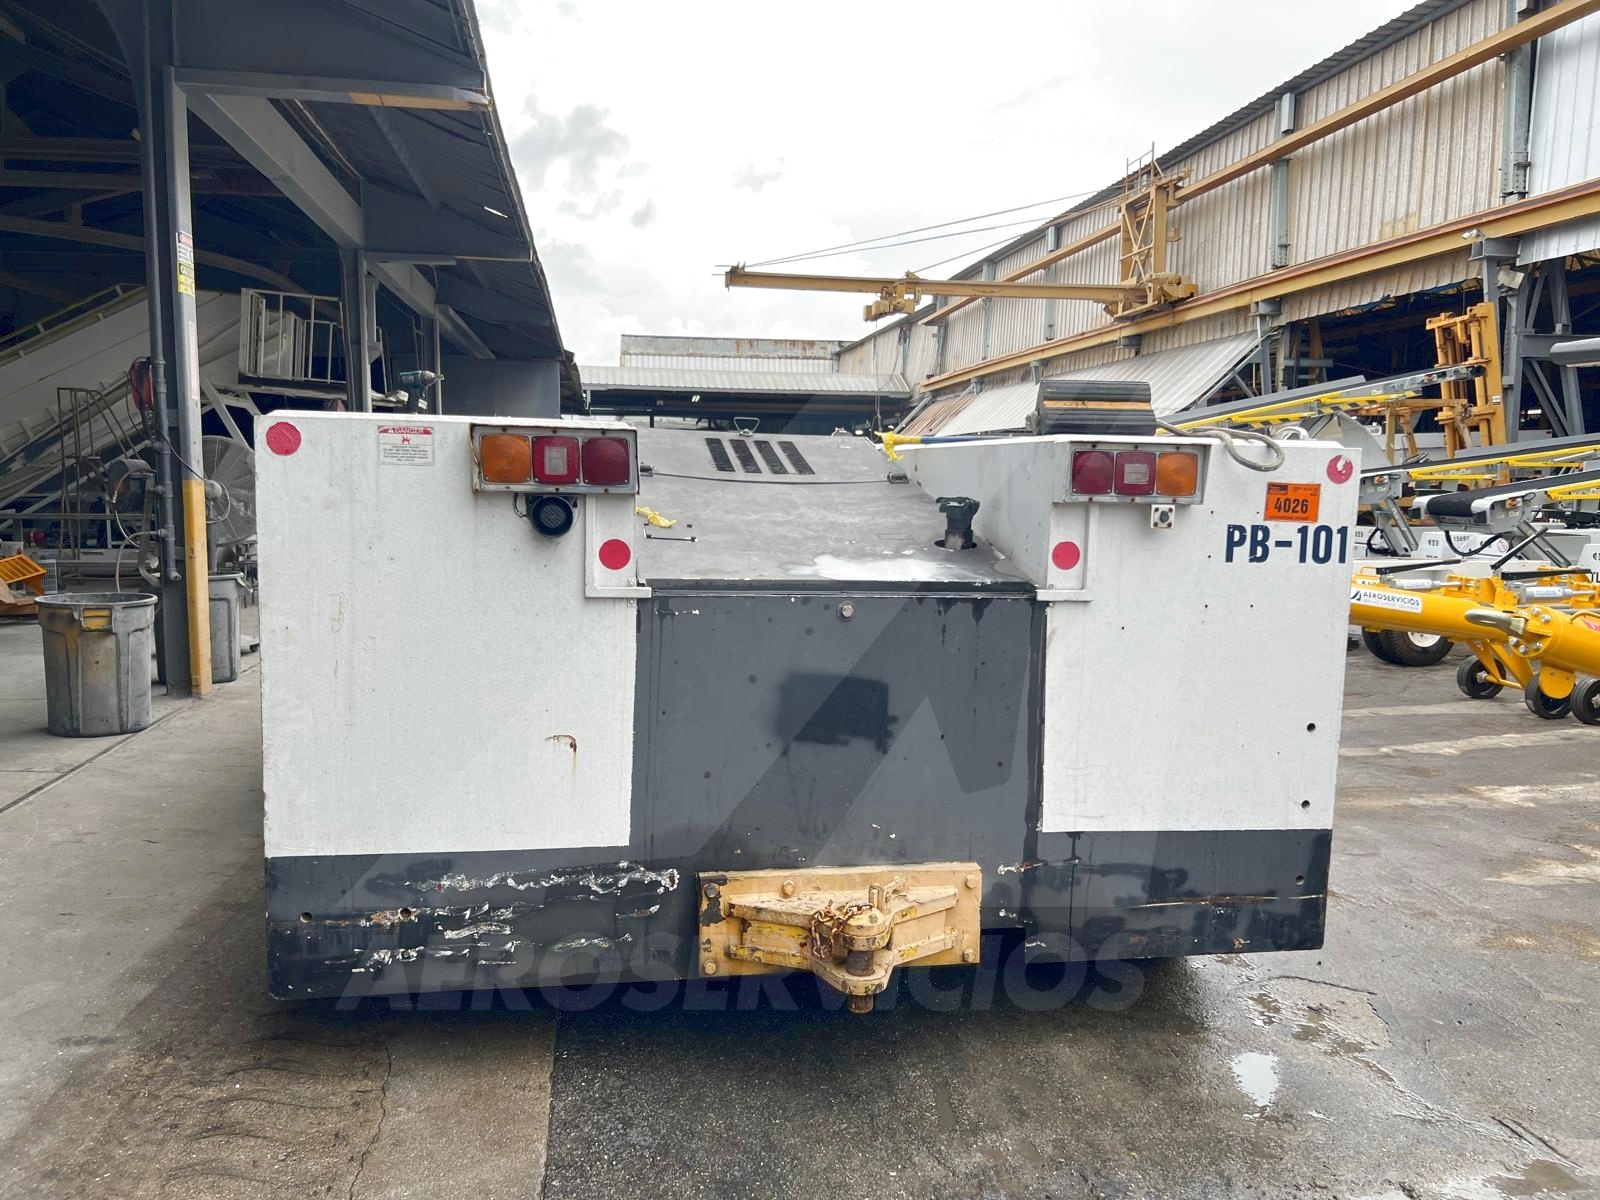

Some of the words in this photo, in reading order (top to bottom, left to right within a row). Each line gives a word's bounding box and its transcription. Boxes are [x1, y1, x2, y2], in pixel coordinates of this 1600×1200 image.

[393, 427, 423, 435] DANGER
[1273, 497, 1309, 514] 4026
[1225, 524, 1348, 564] PB-101
[1363, 591, 1420, 606] AEROSERVICIOS
